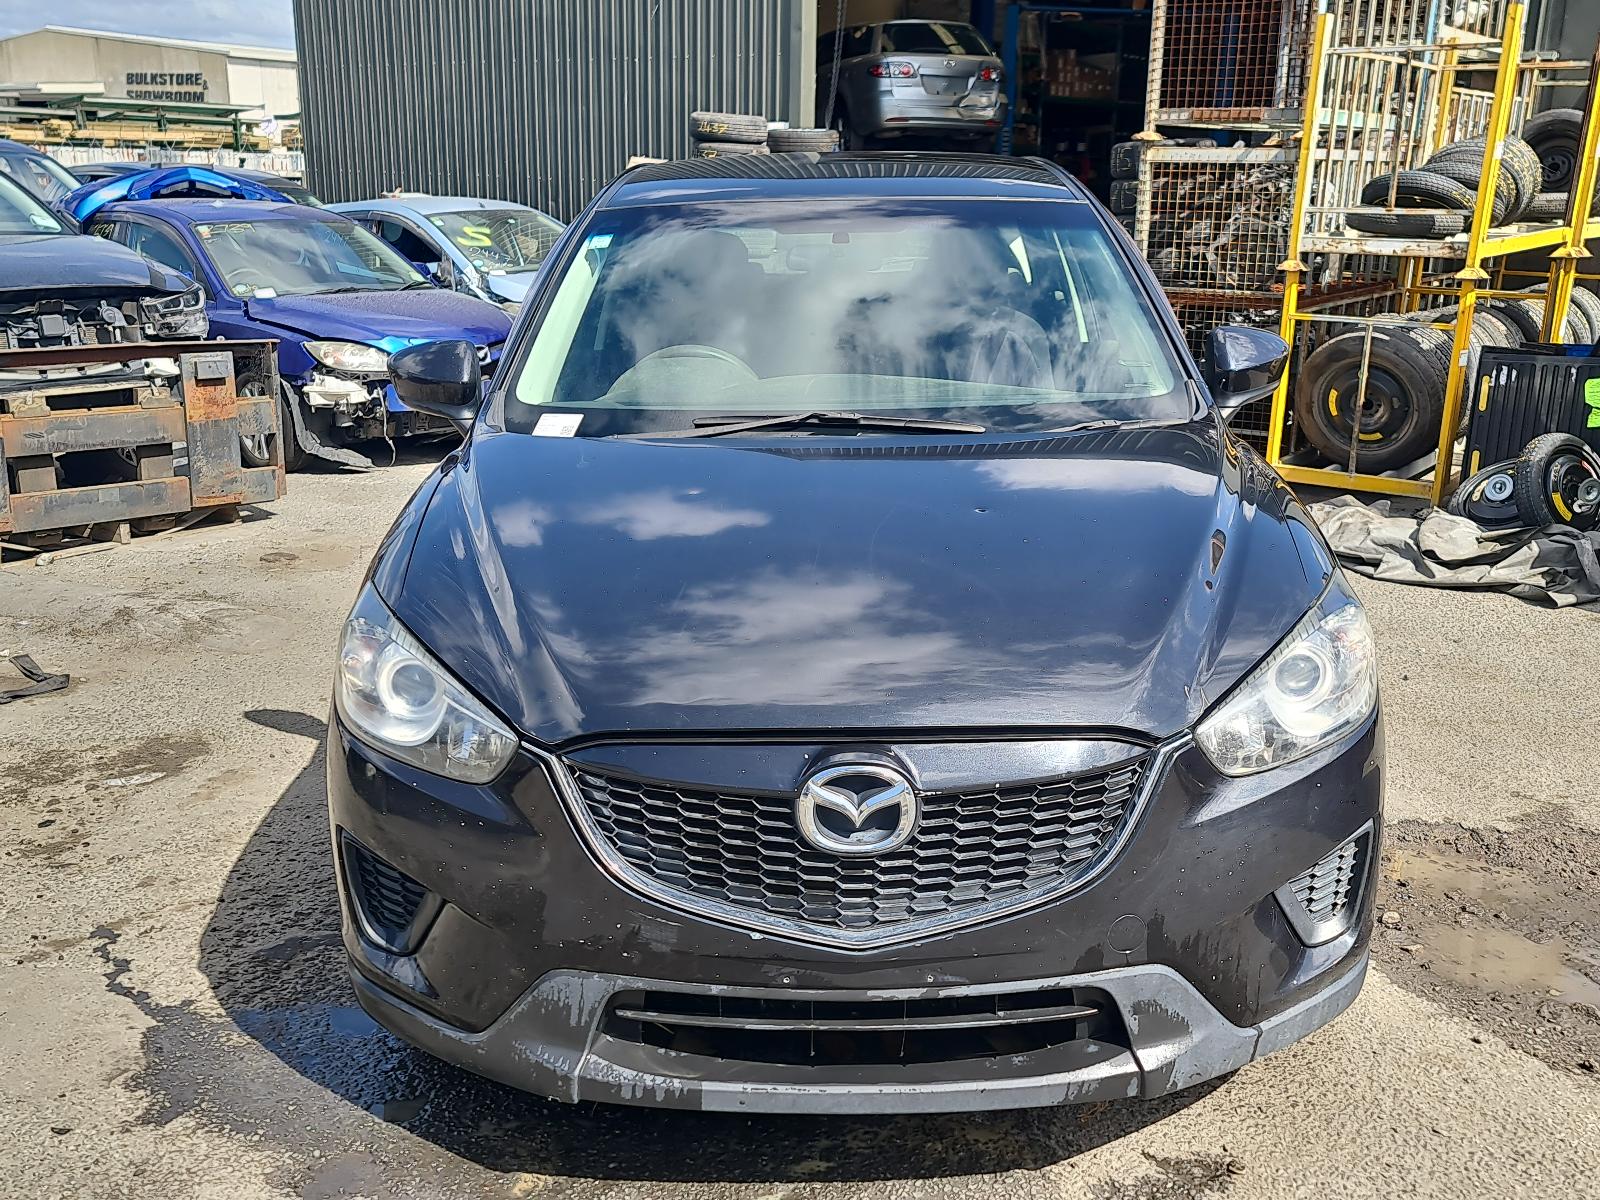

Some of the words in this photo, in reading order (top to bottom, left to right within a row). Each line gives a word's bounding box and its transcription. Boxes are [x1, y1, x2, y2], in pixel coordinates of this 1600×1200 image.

[126, 72, 203, 86] BULKSTORE
[126, 90, 205, 103] SHOWROOM
[456, 226, 493, 248] S
